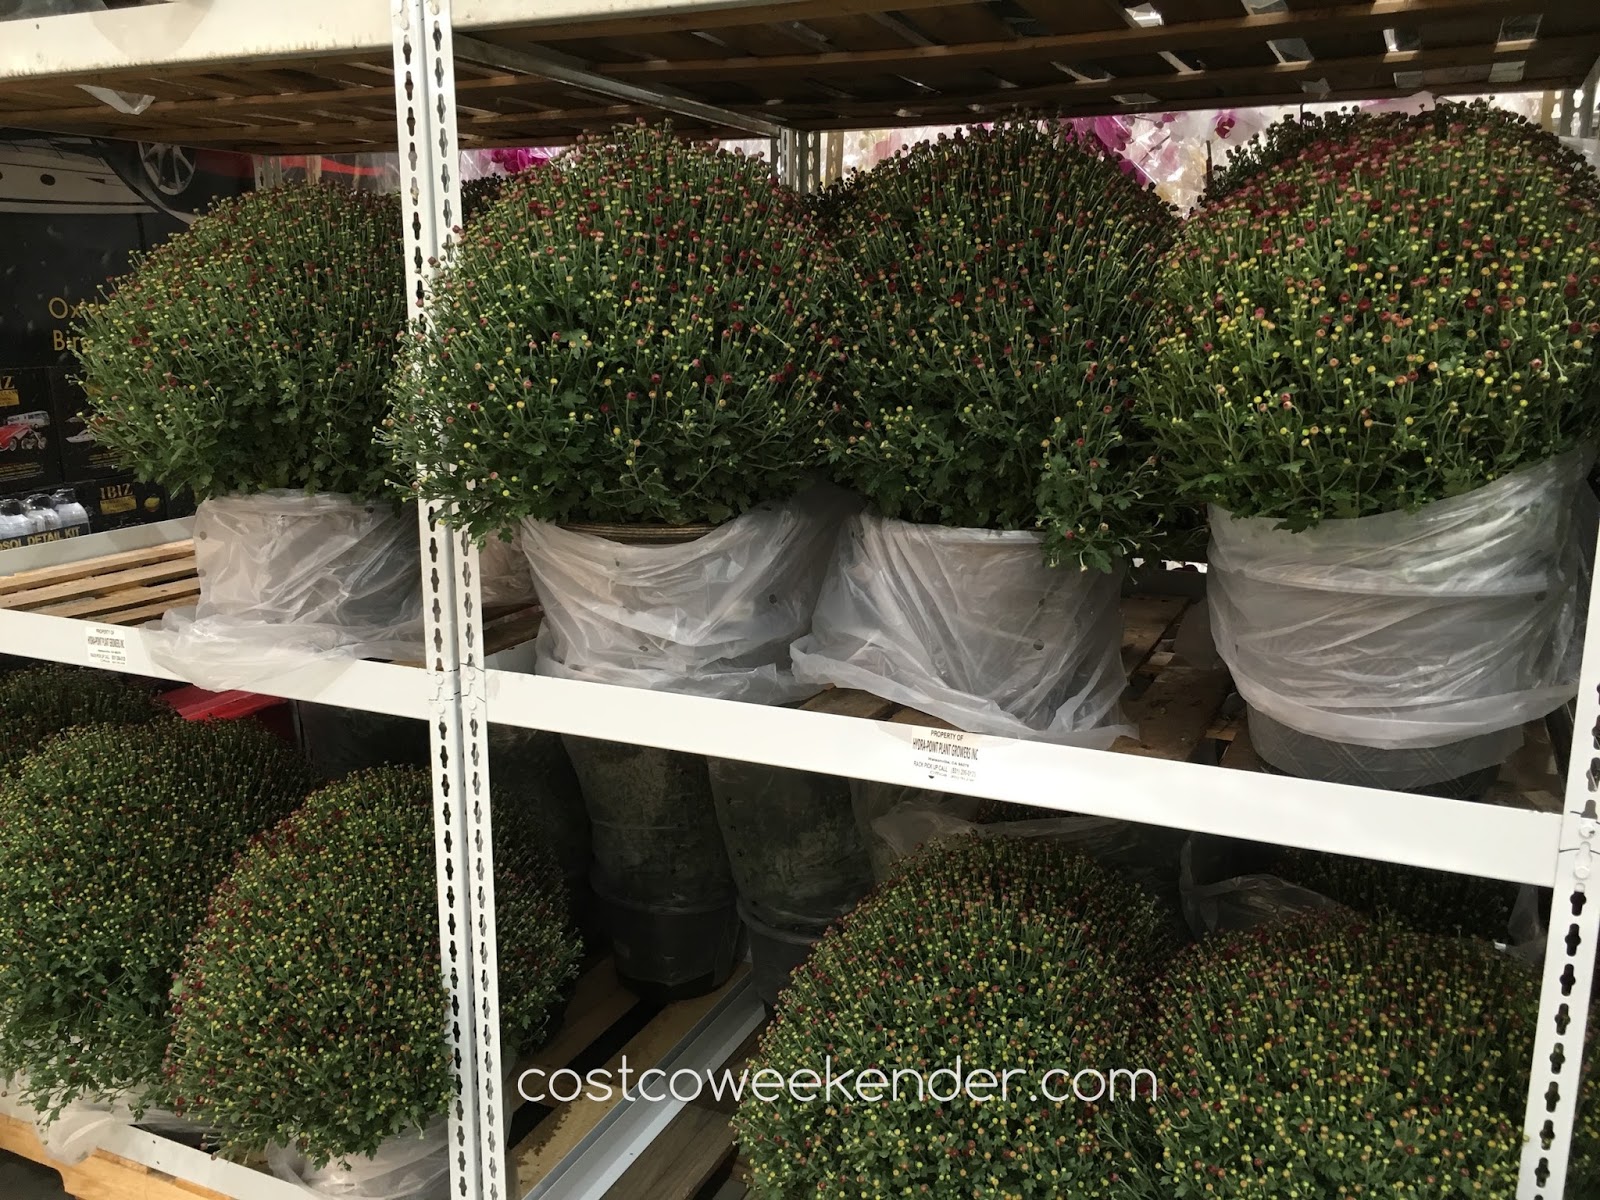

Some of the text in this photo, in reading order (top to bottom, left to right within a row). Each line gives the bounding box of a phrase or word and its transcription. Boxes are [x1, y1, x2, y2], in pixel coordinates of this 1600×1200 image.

[100, 483, 134, 500] IBIZ
[0, 527, 81, 551] SOL DETAIL KIT
[930, 729, 956, 740] PROPERTY
[912, 738, 938, 753] HYDRA-POINT
[938, 742, 951, 756] PLANT
[951, 744, 971, 760] GROWERS
[923, 762, 933, 770] PICK
